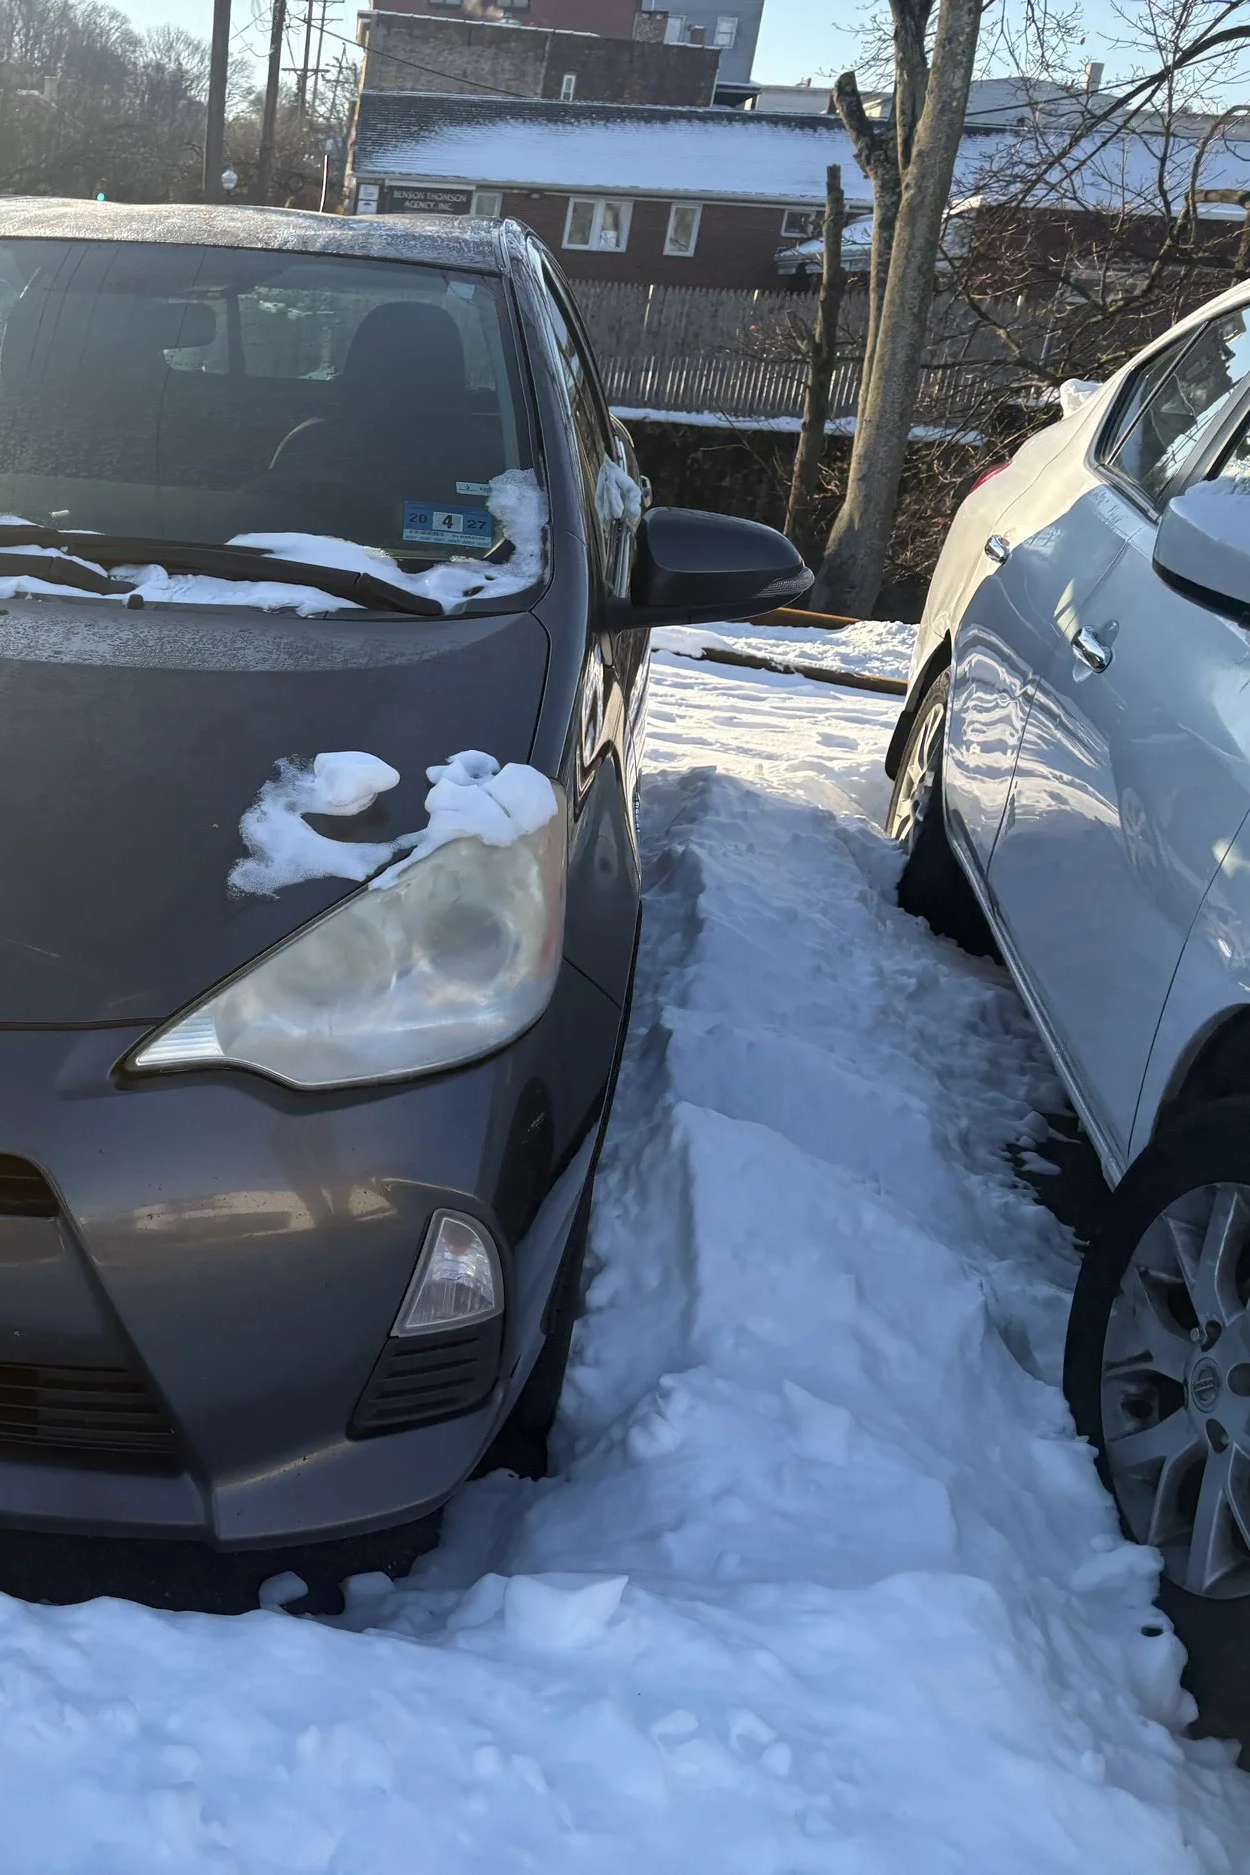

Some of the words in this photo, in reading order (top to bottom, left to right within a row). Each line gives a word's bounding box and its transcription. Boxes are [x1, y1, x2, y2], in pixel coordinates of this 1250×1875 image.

[409, 513, 427, 524] 20
[442, 515, 454, 529] 4
[467, 519, 487, 530] 27
